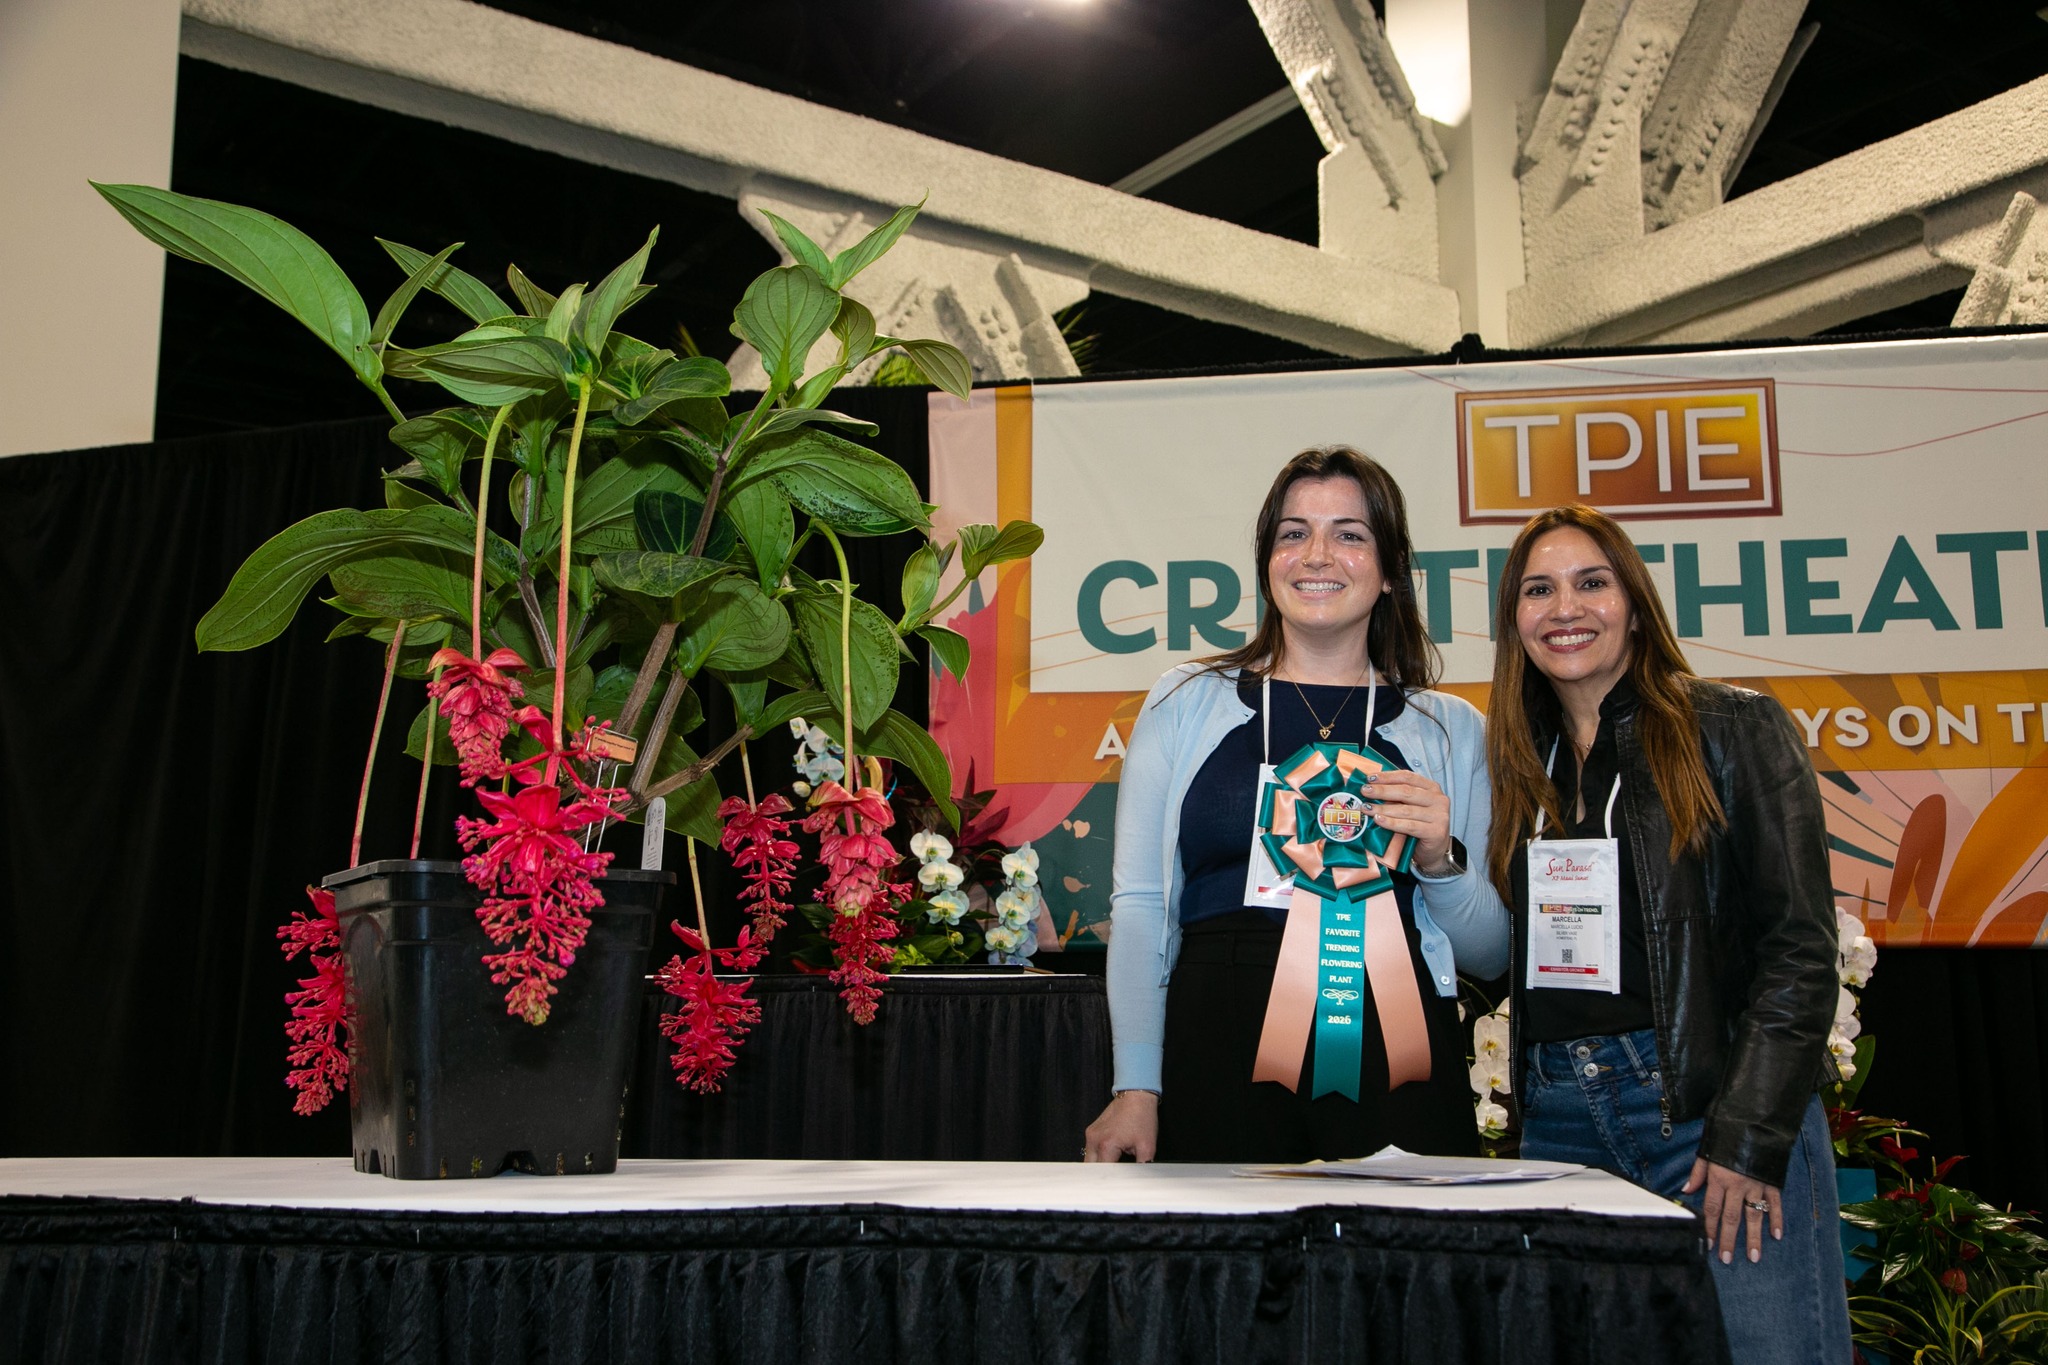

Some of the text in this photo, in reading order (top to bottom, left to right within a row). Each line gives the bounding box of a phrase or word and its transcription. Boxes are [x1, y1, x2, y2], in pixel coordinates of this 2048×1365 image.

[1484, 406, 1750, 498] TPIE
[1077, 530, 2048, 655] CRT HEAT
[1792, 706, 1870, 748] YS
[1888, 704, 1979, 747] ON
[1327, 810, 1358, 824] TPIE
[1546, 858, 1565, 876] Sun
[1325, 927, 1361, 938] FAVORITE
[1324, 943, 1360, 953] TRENDING
[1320, 958, 1363, 969] FLOWERING
[1329, 975, 1353, 984] PLANT
[1327, 1015, 1352, 1025] 2026
